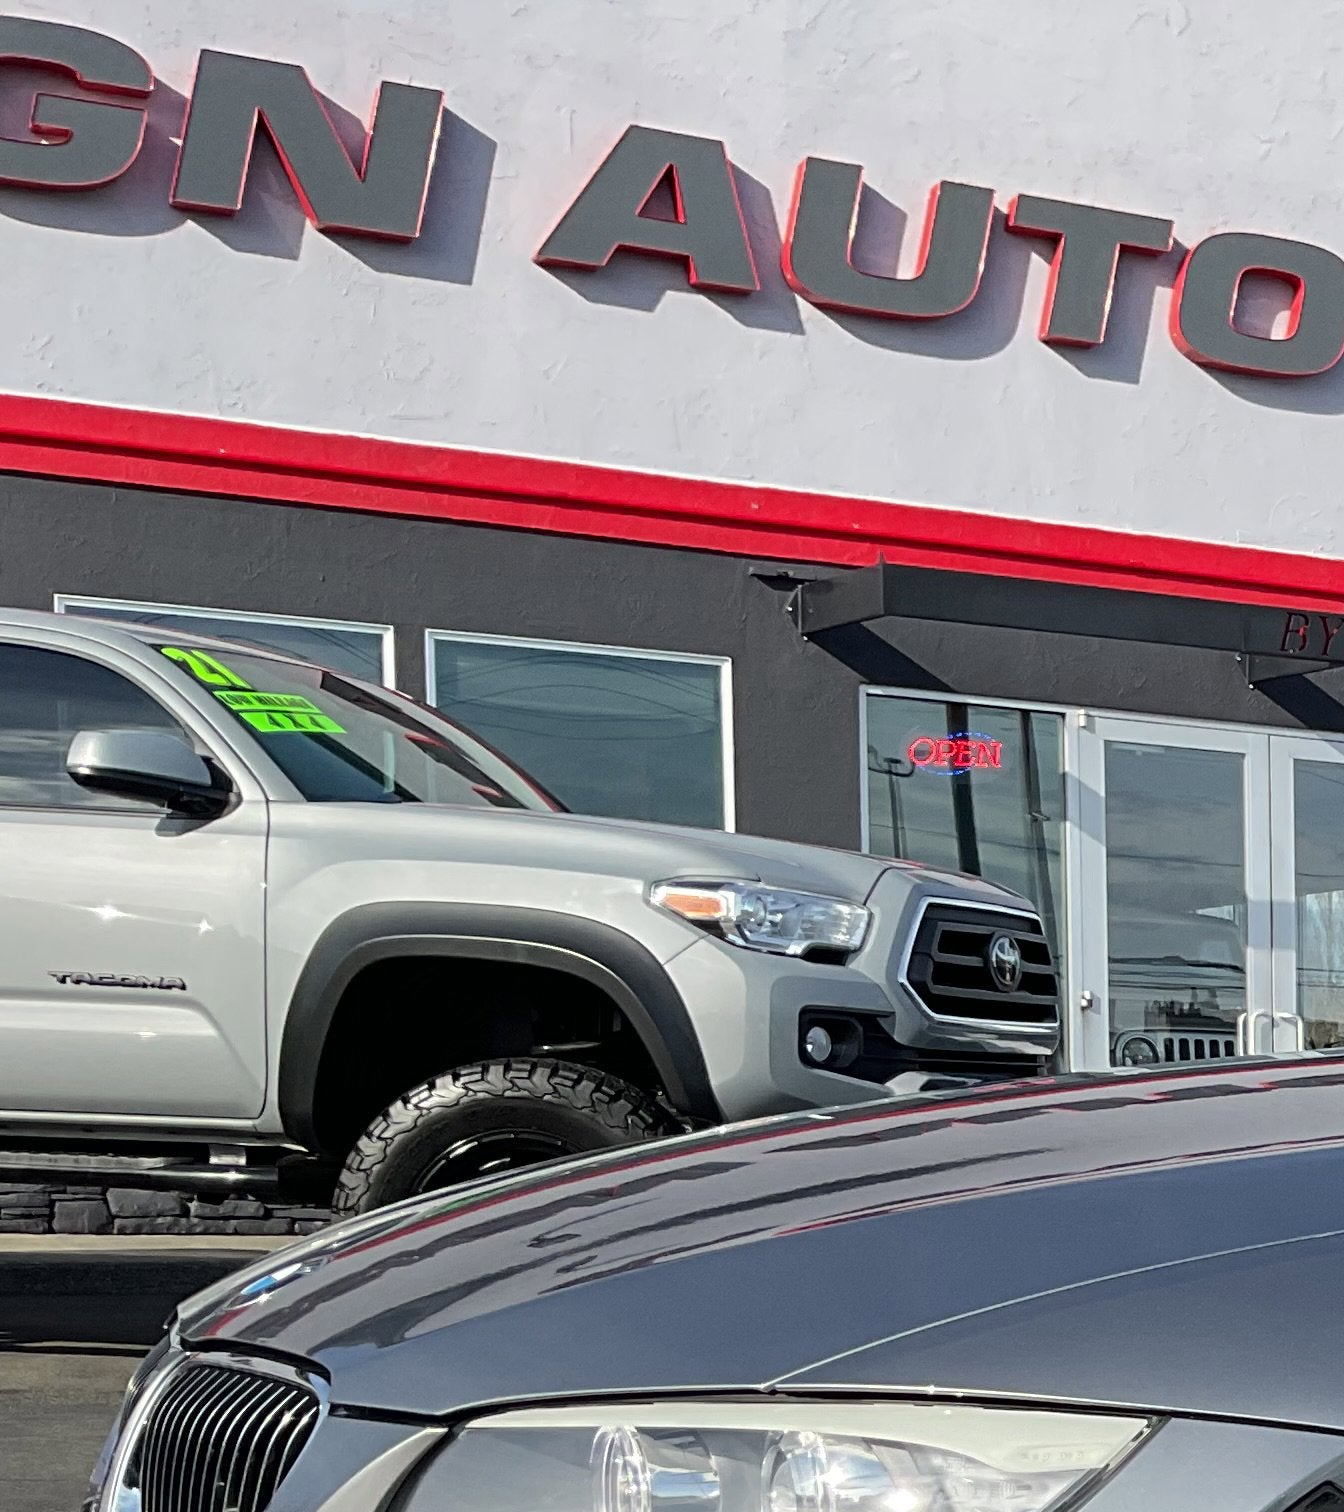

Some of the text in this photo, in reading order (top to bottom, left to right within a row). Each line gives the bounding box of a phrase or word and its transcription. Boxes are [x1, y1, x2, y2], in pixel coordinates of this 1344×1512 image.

[0, 15, 446, 243] GN
[907, 736, 1003, 769] OPEN
[47, 969, 187, 991] TACOMA
